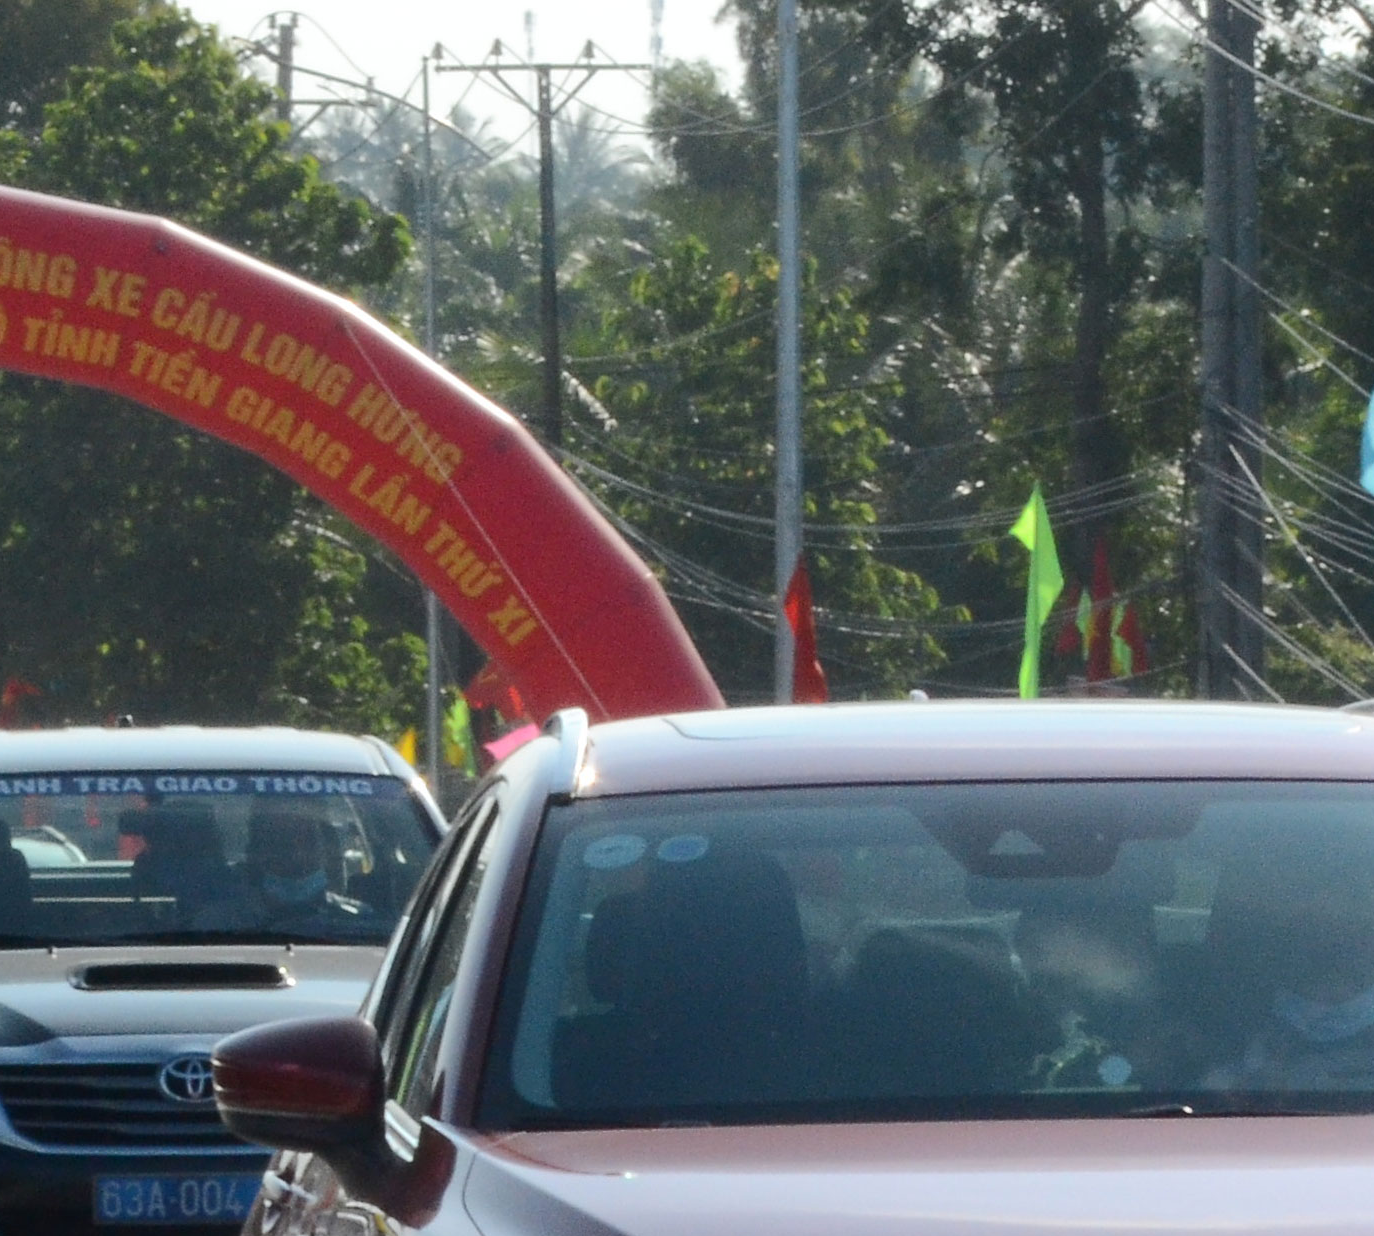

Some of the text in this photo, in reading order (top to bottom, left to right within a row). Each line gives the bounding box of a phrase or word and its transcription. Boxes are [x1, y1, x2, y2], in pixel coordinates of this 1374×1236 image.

[86, 266, 147, 317] XE
[240, 322, 353, 406] LONG
[226, 385, 352, 480] GIANG
[488, 595, 537, 646] XI
[73, 777, 145, 794] TRA
[155, 775, 238, 793] GIAO
[251, 775, 373, 796] THÔNG
[100, 1179, 245, 1218] 63A-004
